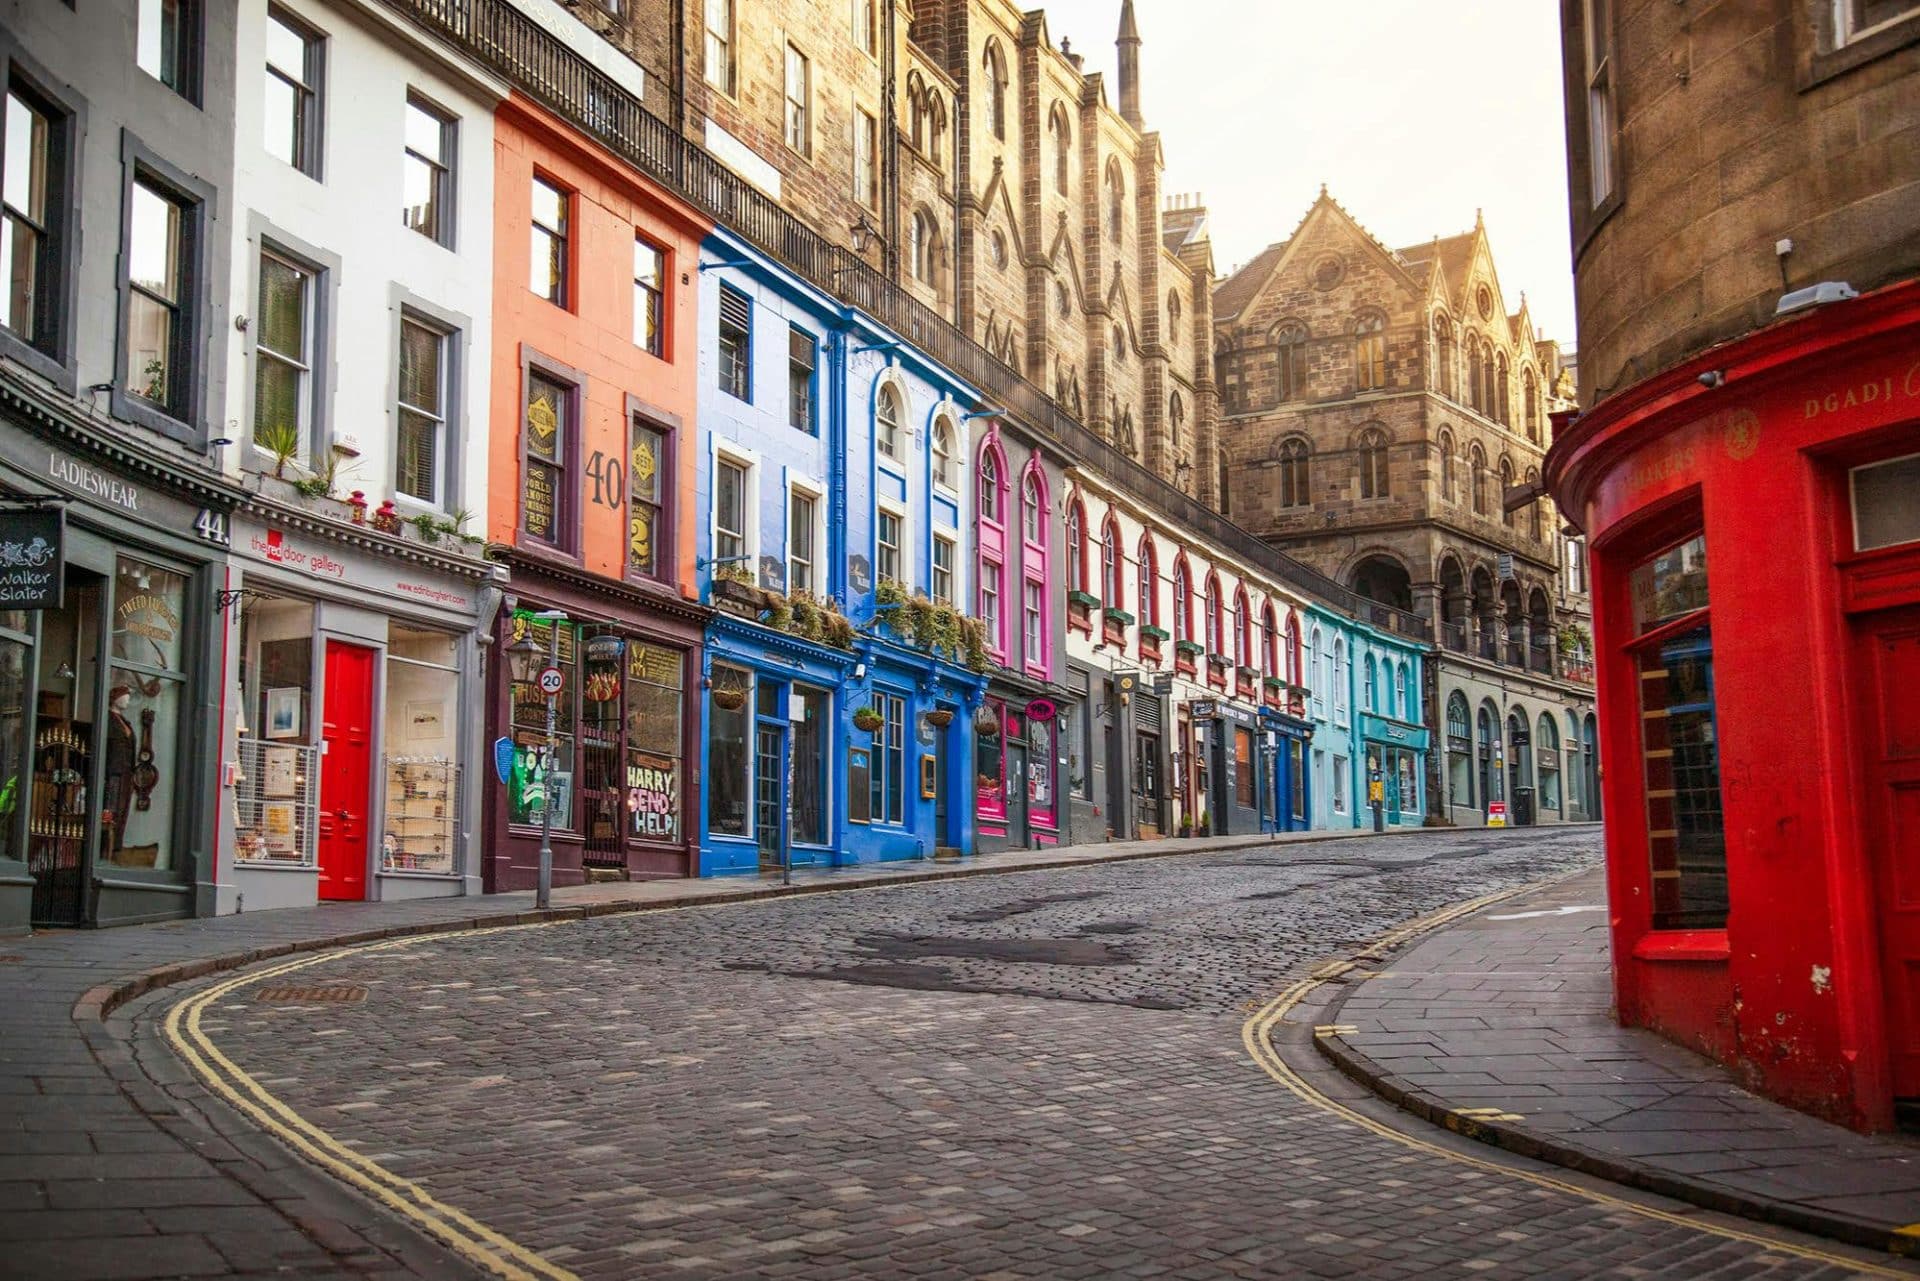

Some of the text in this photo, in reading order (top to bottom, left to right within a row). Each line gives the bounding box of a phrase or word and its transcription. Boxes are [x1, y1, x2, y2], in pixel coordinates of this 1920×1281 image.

[50, 453, 138, 511] LADIESWEAR
[585, 450, 622, 510] 40
[251, 534, 345, 578] the red door gallery
[542, 675, 561, 687] 20
[629, 788, 669, 814] SEND
[635, 810, 677, 842] HELP!
